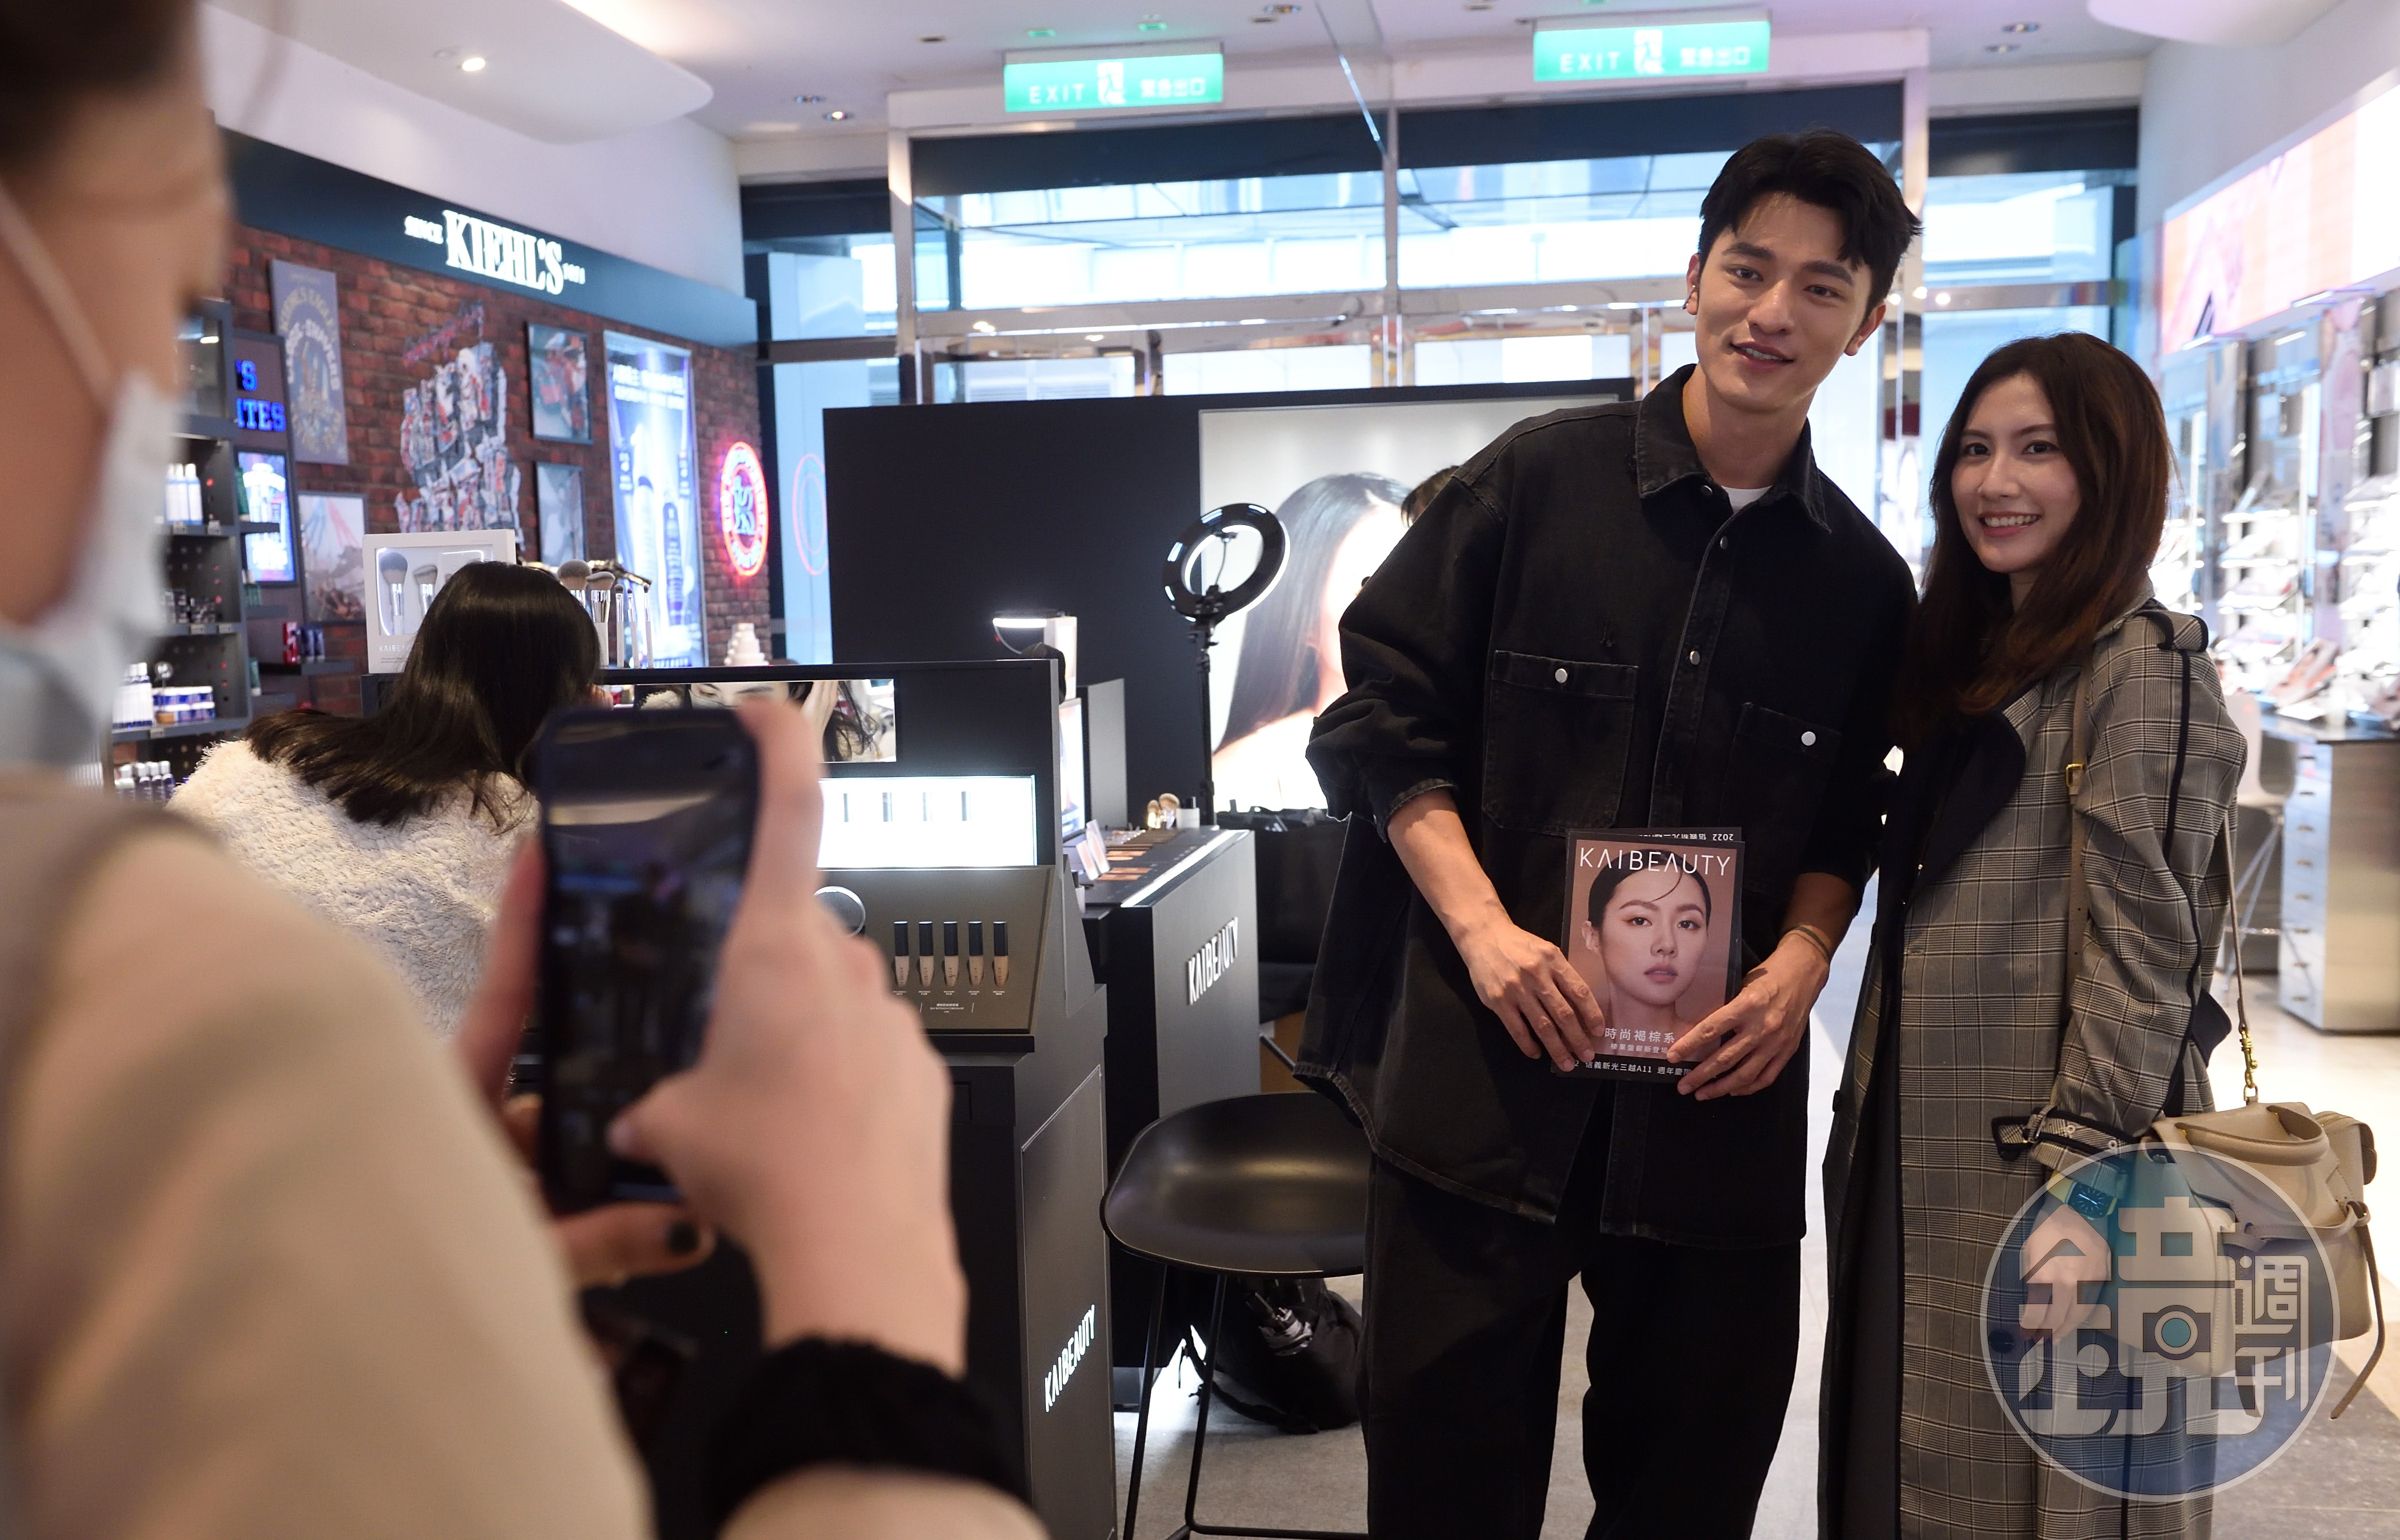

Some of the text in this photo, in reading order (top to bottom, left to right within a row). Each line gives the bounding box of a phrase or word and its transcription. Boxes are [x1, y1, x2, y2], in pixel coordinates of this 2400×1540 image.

[1559, 52, 1620, 73] EXIT
[1029, 83, 1084, 104] EXIT
[442, 209, 564, 296] KIEHL'S
[1712, 833, 1734, 841] 2022
[1579, 847, 1732, 876] KAIBEAUTY
[1187, 916, 1239, 1006] KAIBEAUTY
[1604, 1027, 1676, 1044] 時尚褐棕系
[1585, 1061, 1652, 1074] 信義新光三越A11
[1044, 1304, 1095, 1413] KAIBEAUTY
